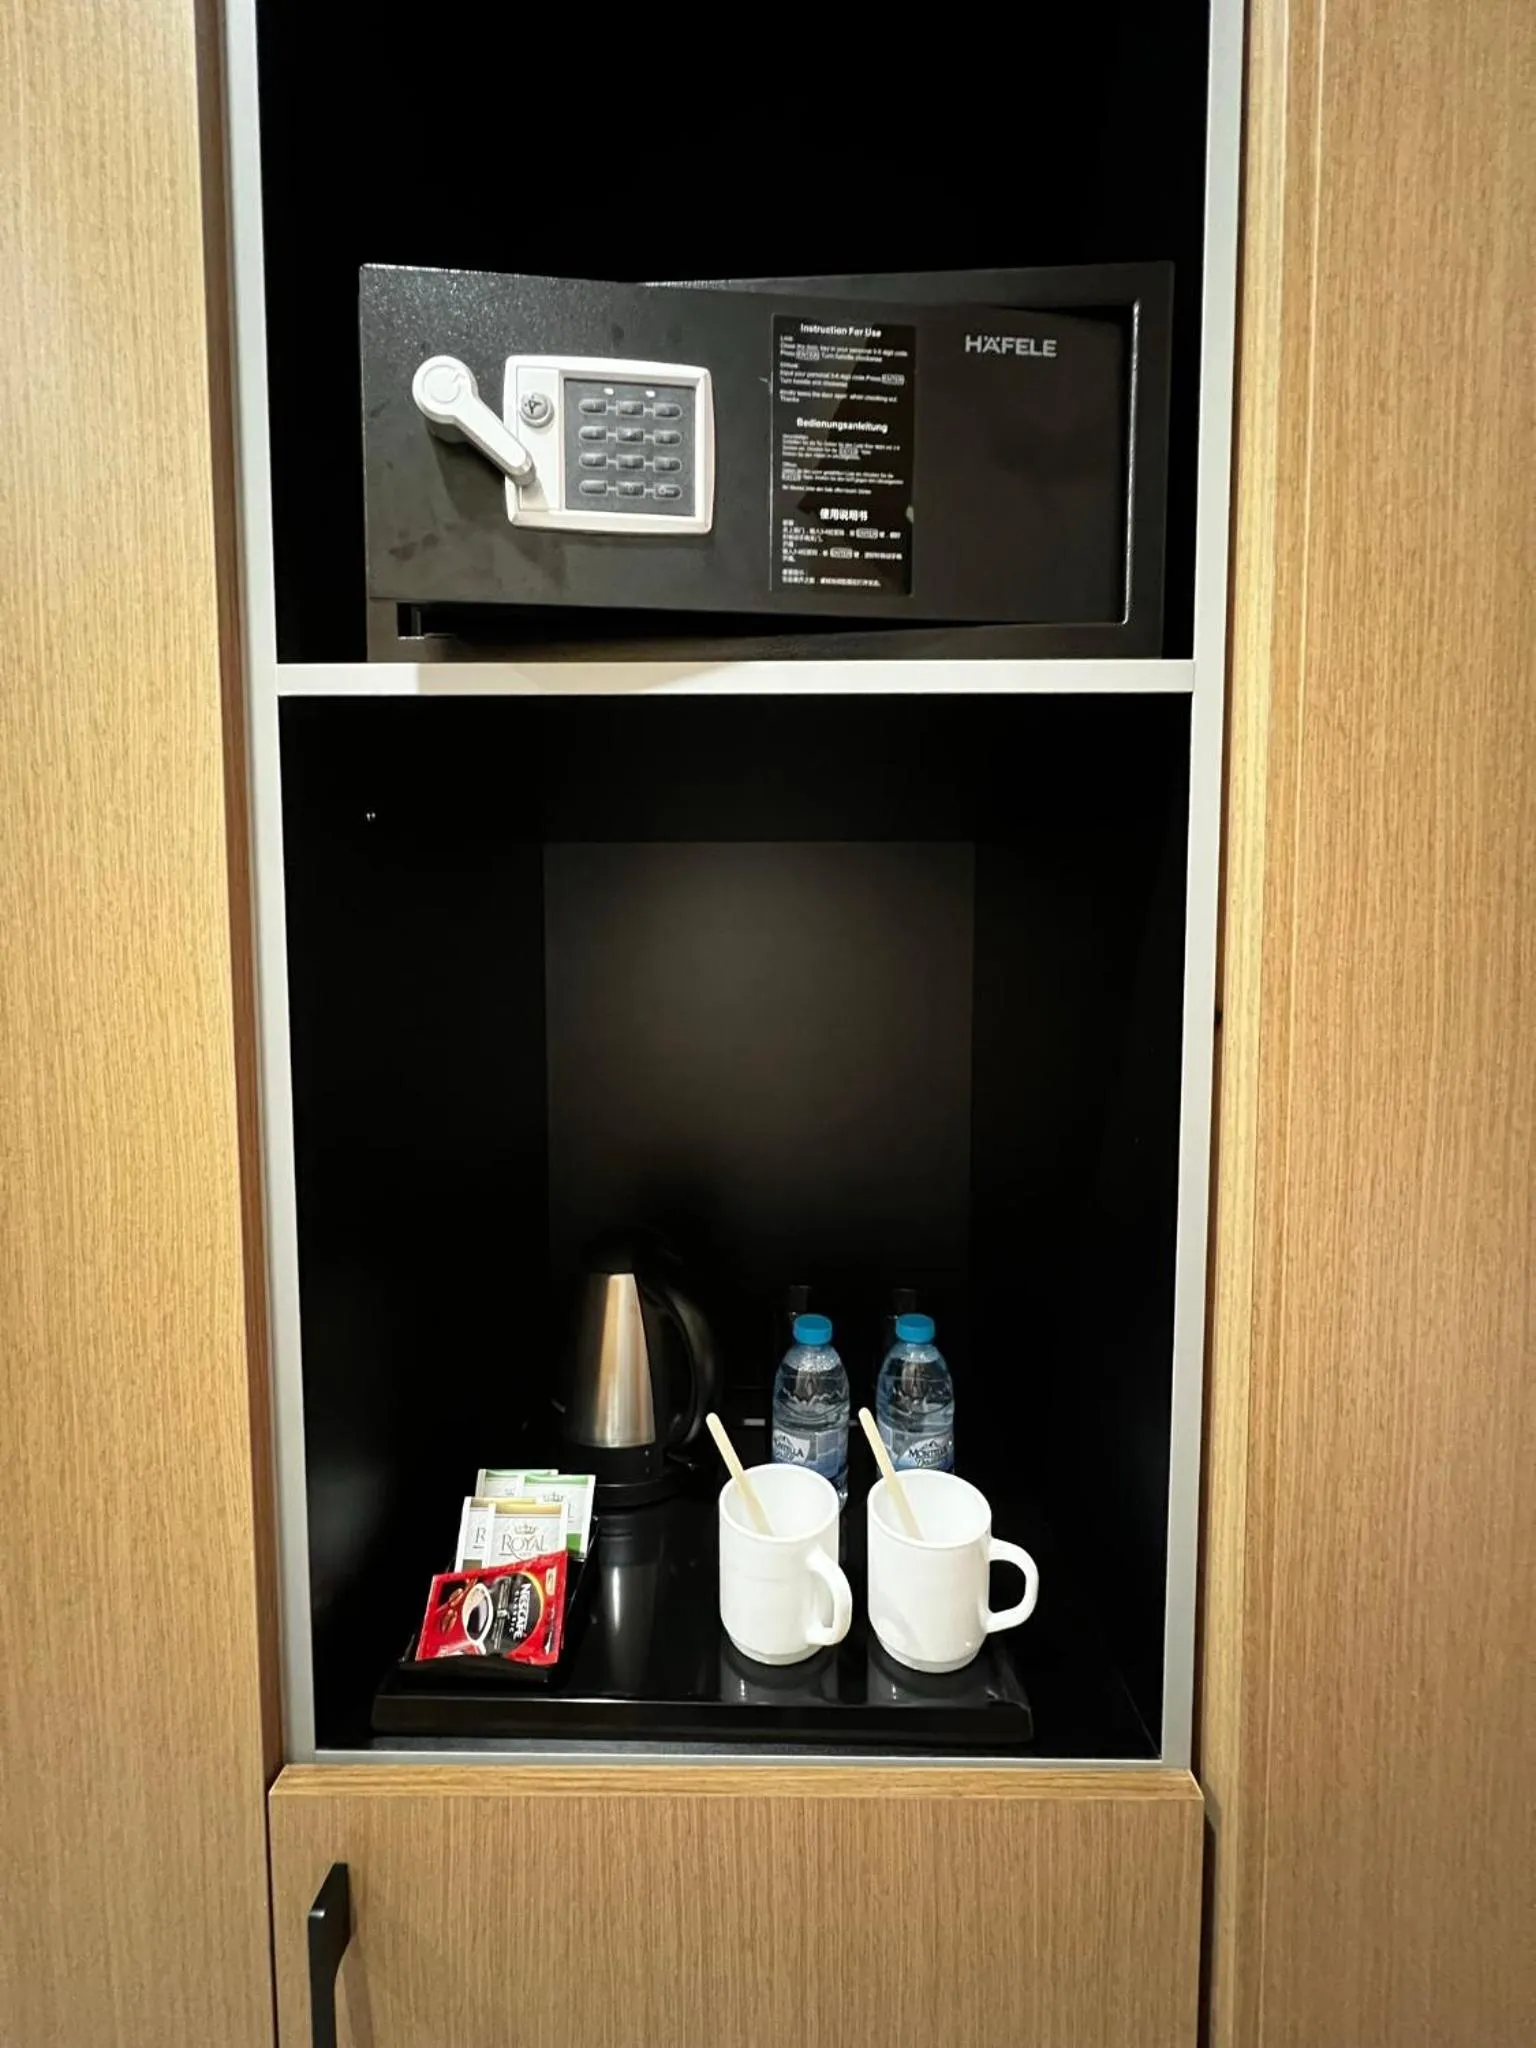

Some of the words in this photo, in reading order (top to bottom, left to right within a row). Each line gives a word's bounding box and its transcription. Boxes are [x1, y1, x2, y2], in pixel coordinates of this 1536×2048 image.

[800, 323, 847, 336] Instruction
[848, 327, 863, 337] For
[865, 328, 881, 338] Use
[965, 334, 1057, 357] HÄFELE
[796, 417, 888, 434] Bedienungsanleitung
[820, 508, 868, 521] 使用说明书
[501, 1533, 547, 1551] ROYAL
